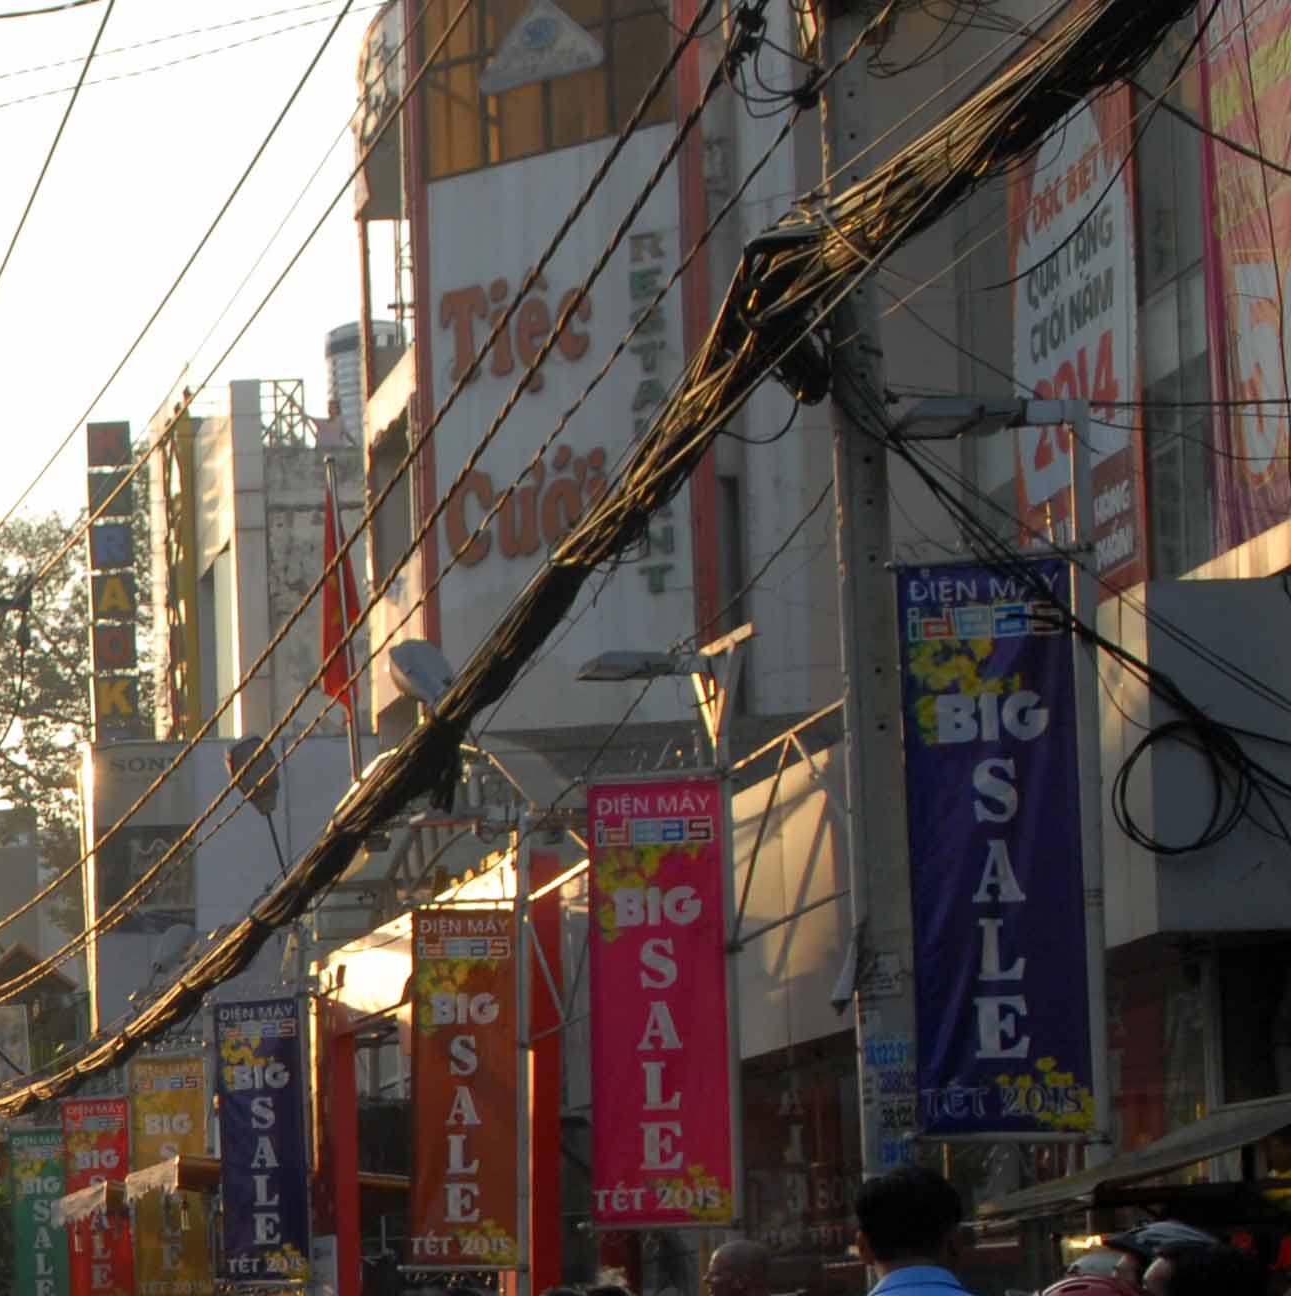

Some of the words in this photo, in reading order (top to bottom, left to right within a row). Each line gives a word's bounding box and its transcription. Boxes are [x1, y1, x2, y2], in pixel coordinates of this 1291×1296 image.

[908, 576, 978, 606] ĐIỆN
[935, 689, 1049, 743] BIG
[595, 793, 651, 818] ĐIỆN
[613, 885, 702, 928] BIG
[972, 757, 1032, 1060] SALE
[430, 992, 500, 1026] BIG
[637, 938, 683, 1171] SALE
[234, 1062, 290, 1090] BIG
[922, 1078, 989, 1120] TẾT
[144, 1113, 193, 1136] BIG
[445, 1034, 482, 1224] SALE
[76, 1149, 120, 1169] BIG
[250, 1097, 280, 1245] SALE
[20, 1175, 61, 1196] BIG
[593, 1181, 647, 1212] TẾT
[411, 1230, 453, 1257] TẾT
